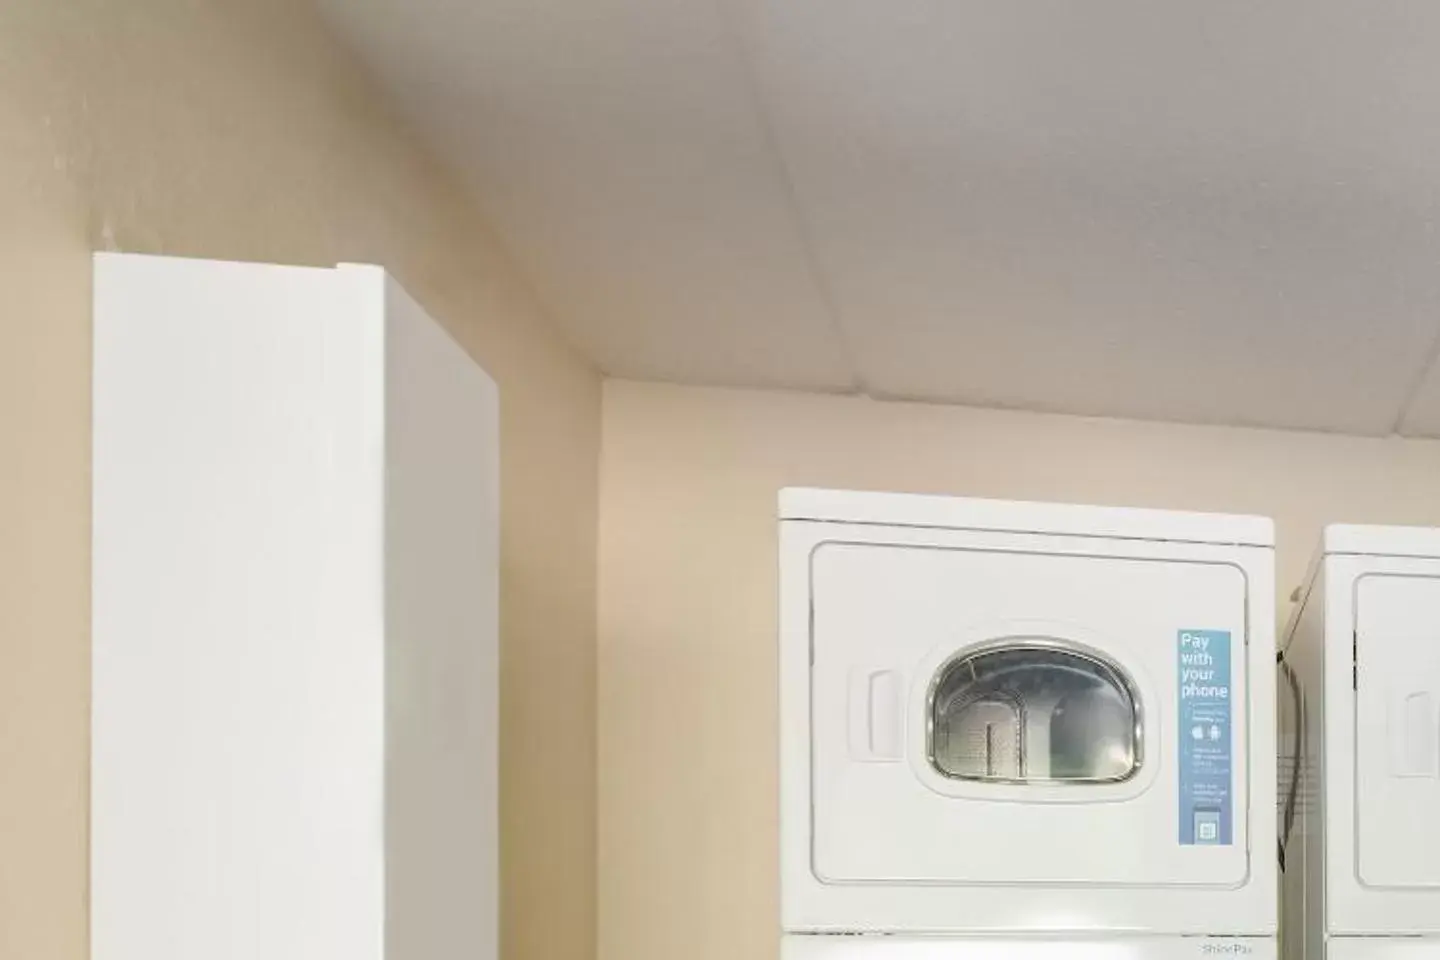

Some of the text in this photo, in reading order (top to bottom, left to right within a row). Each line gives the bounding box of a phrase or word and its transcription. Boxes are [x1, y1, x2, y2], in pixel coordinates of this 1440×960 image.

[1181, 632, 1210, 651] Pay
[1181, 651, 1213, 666] with
[1181, 669, 1215, 682] your
[1181, 682, 1229, 699] phone
